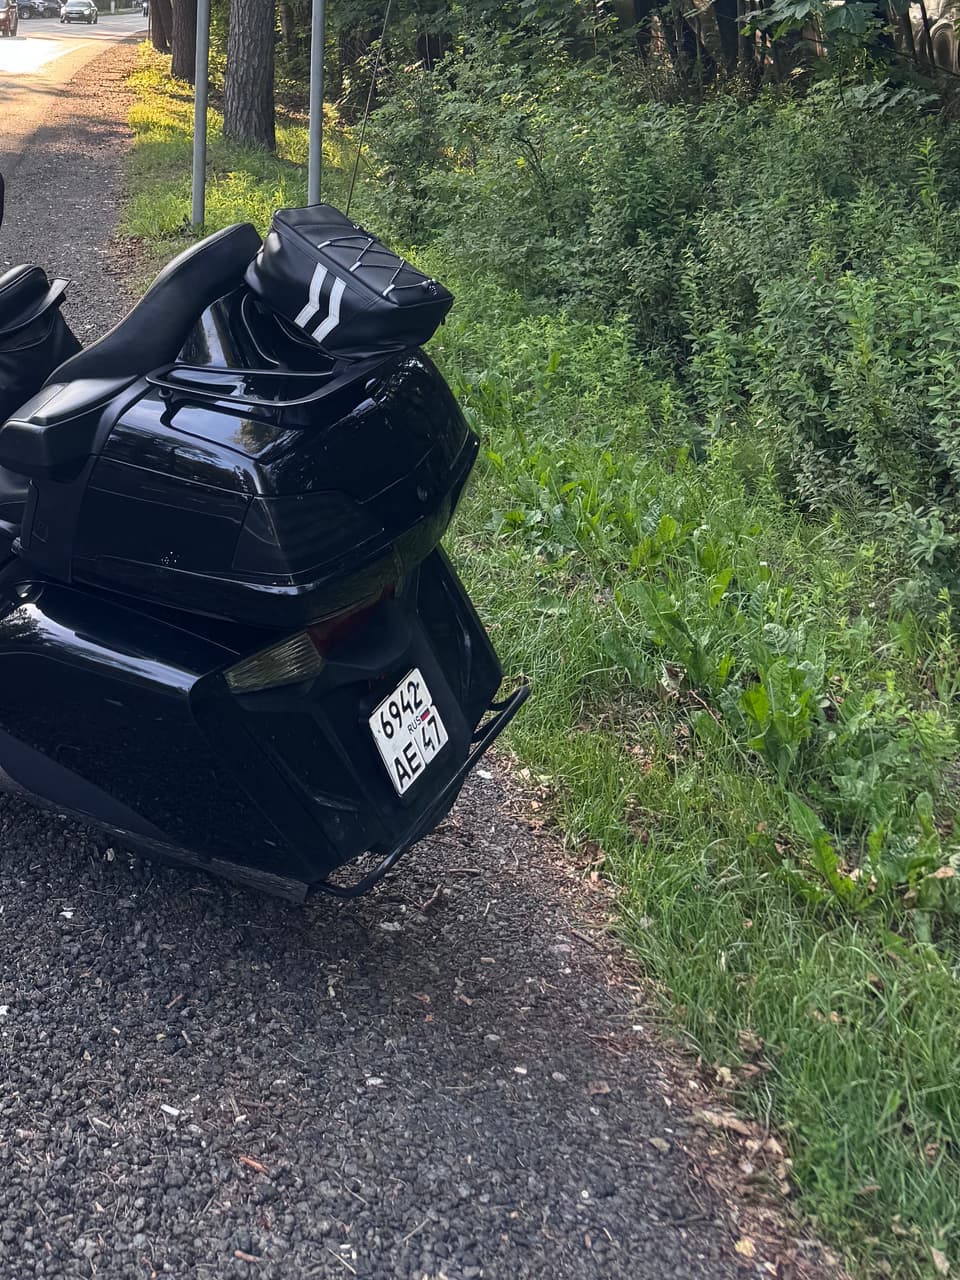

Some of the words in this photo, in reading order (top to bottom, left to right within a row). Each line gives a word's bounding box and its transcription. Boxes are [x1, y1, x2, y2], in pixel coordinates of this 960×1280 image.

[380, 680, 423, 739] 6942
[407, 716, 422, 735] RUS
[421, 715, 442, 752] 47
